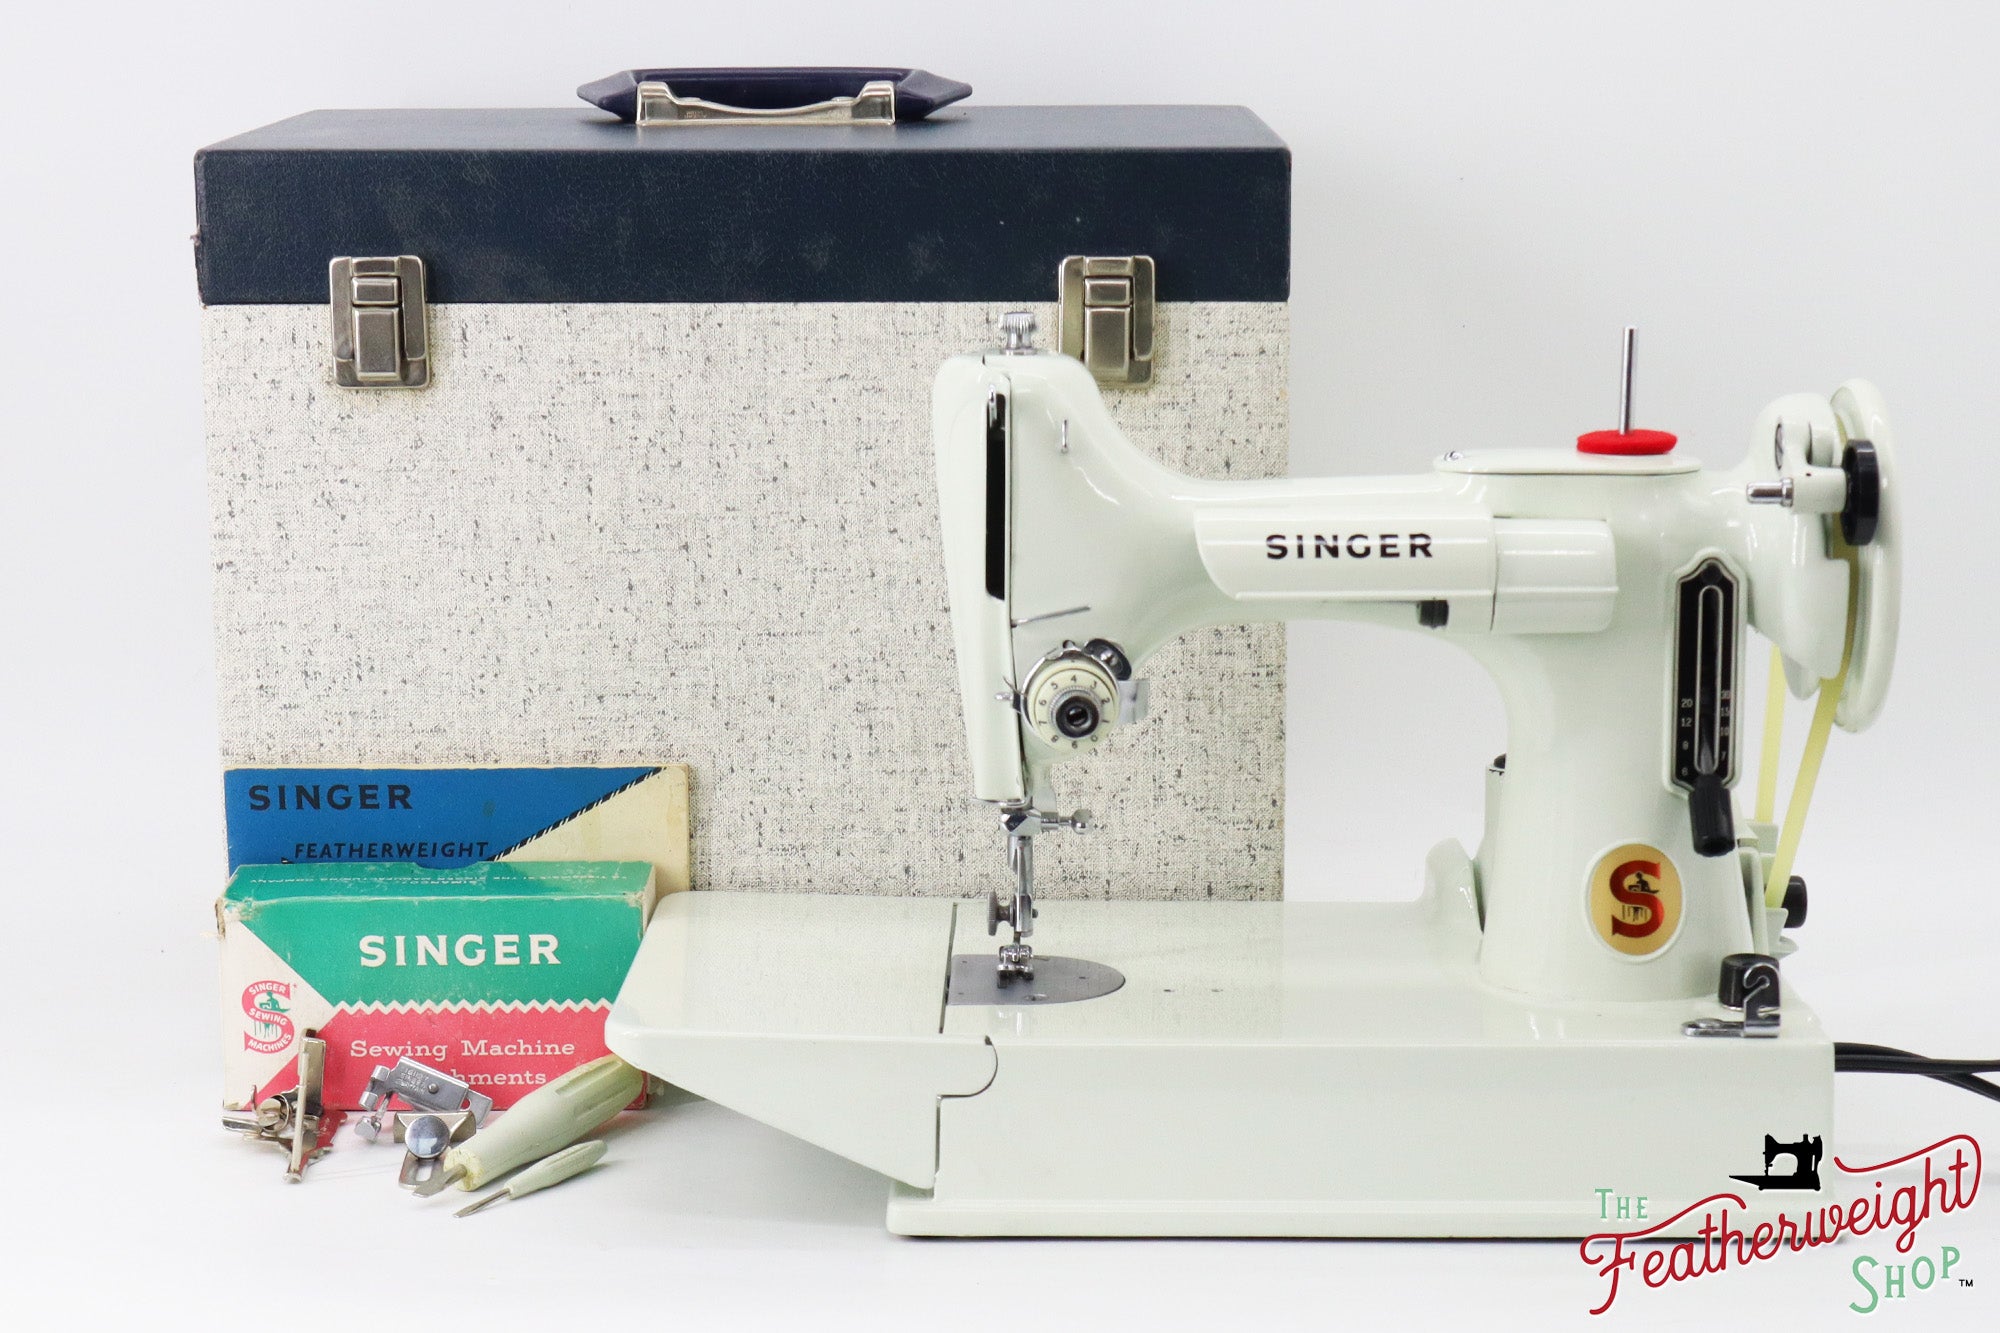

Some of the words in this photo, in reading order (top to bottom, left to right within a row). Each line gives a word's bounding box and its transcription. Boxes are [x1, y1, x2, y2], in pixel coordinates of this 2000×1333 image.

[1266, 533, 1433, 560] SINGER
[1681, 698, 1693, 708] 20
[1681, 718, 1692, 728] 12
[248, 784, 413, 811] SINGER
[295, 842, 489, 859] FEATHERWEIGHT
[359, 934, 561, 967] SINGER
[248, 982, 287, 995] SINGER
[248, 1008, 287, 1026] SEWING
[248, 1033, 292, 1052] MACHINES
[350, 1040, 448, 1061] Sewing
[460, 1039, 576, 1056] Machine
[450, 1069, 547, 1085] hments
